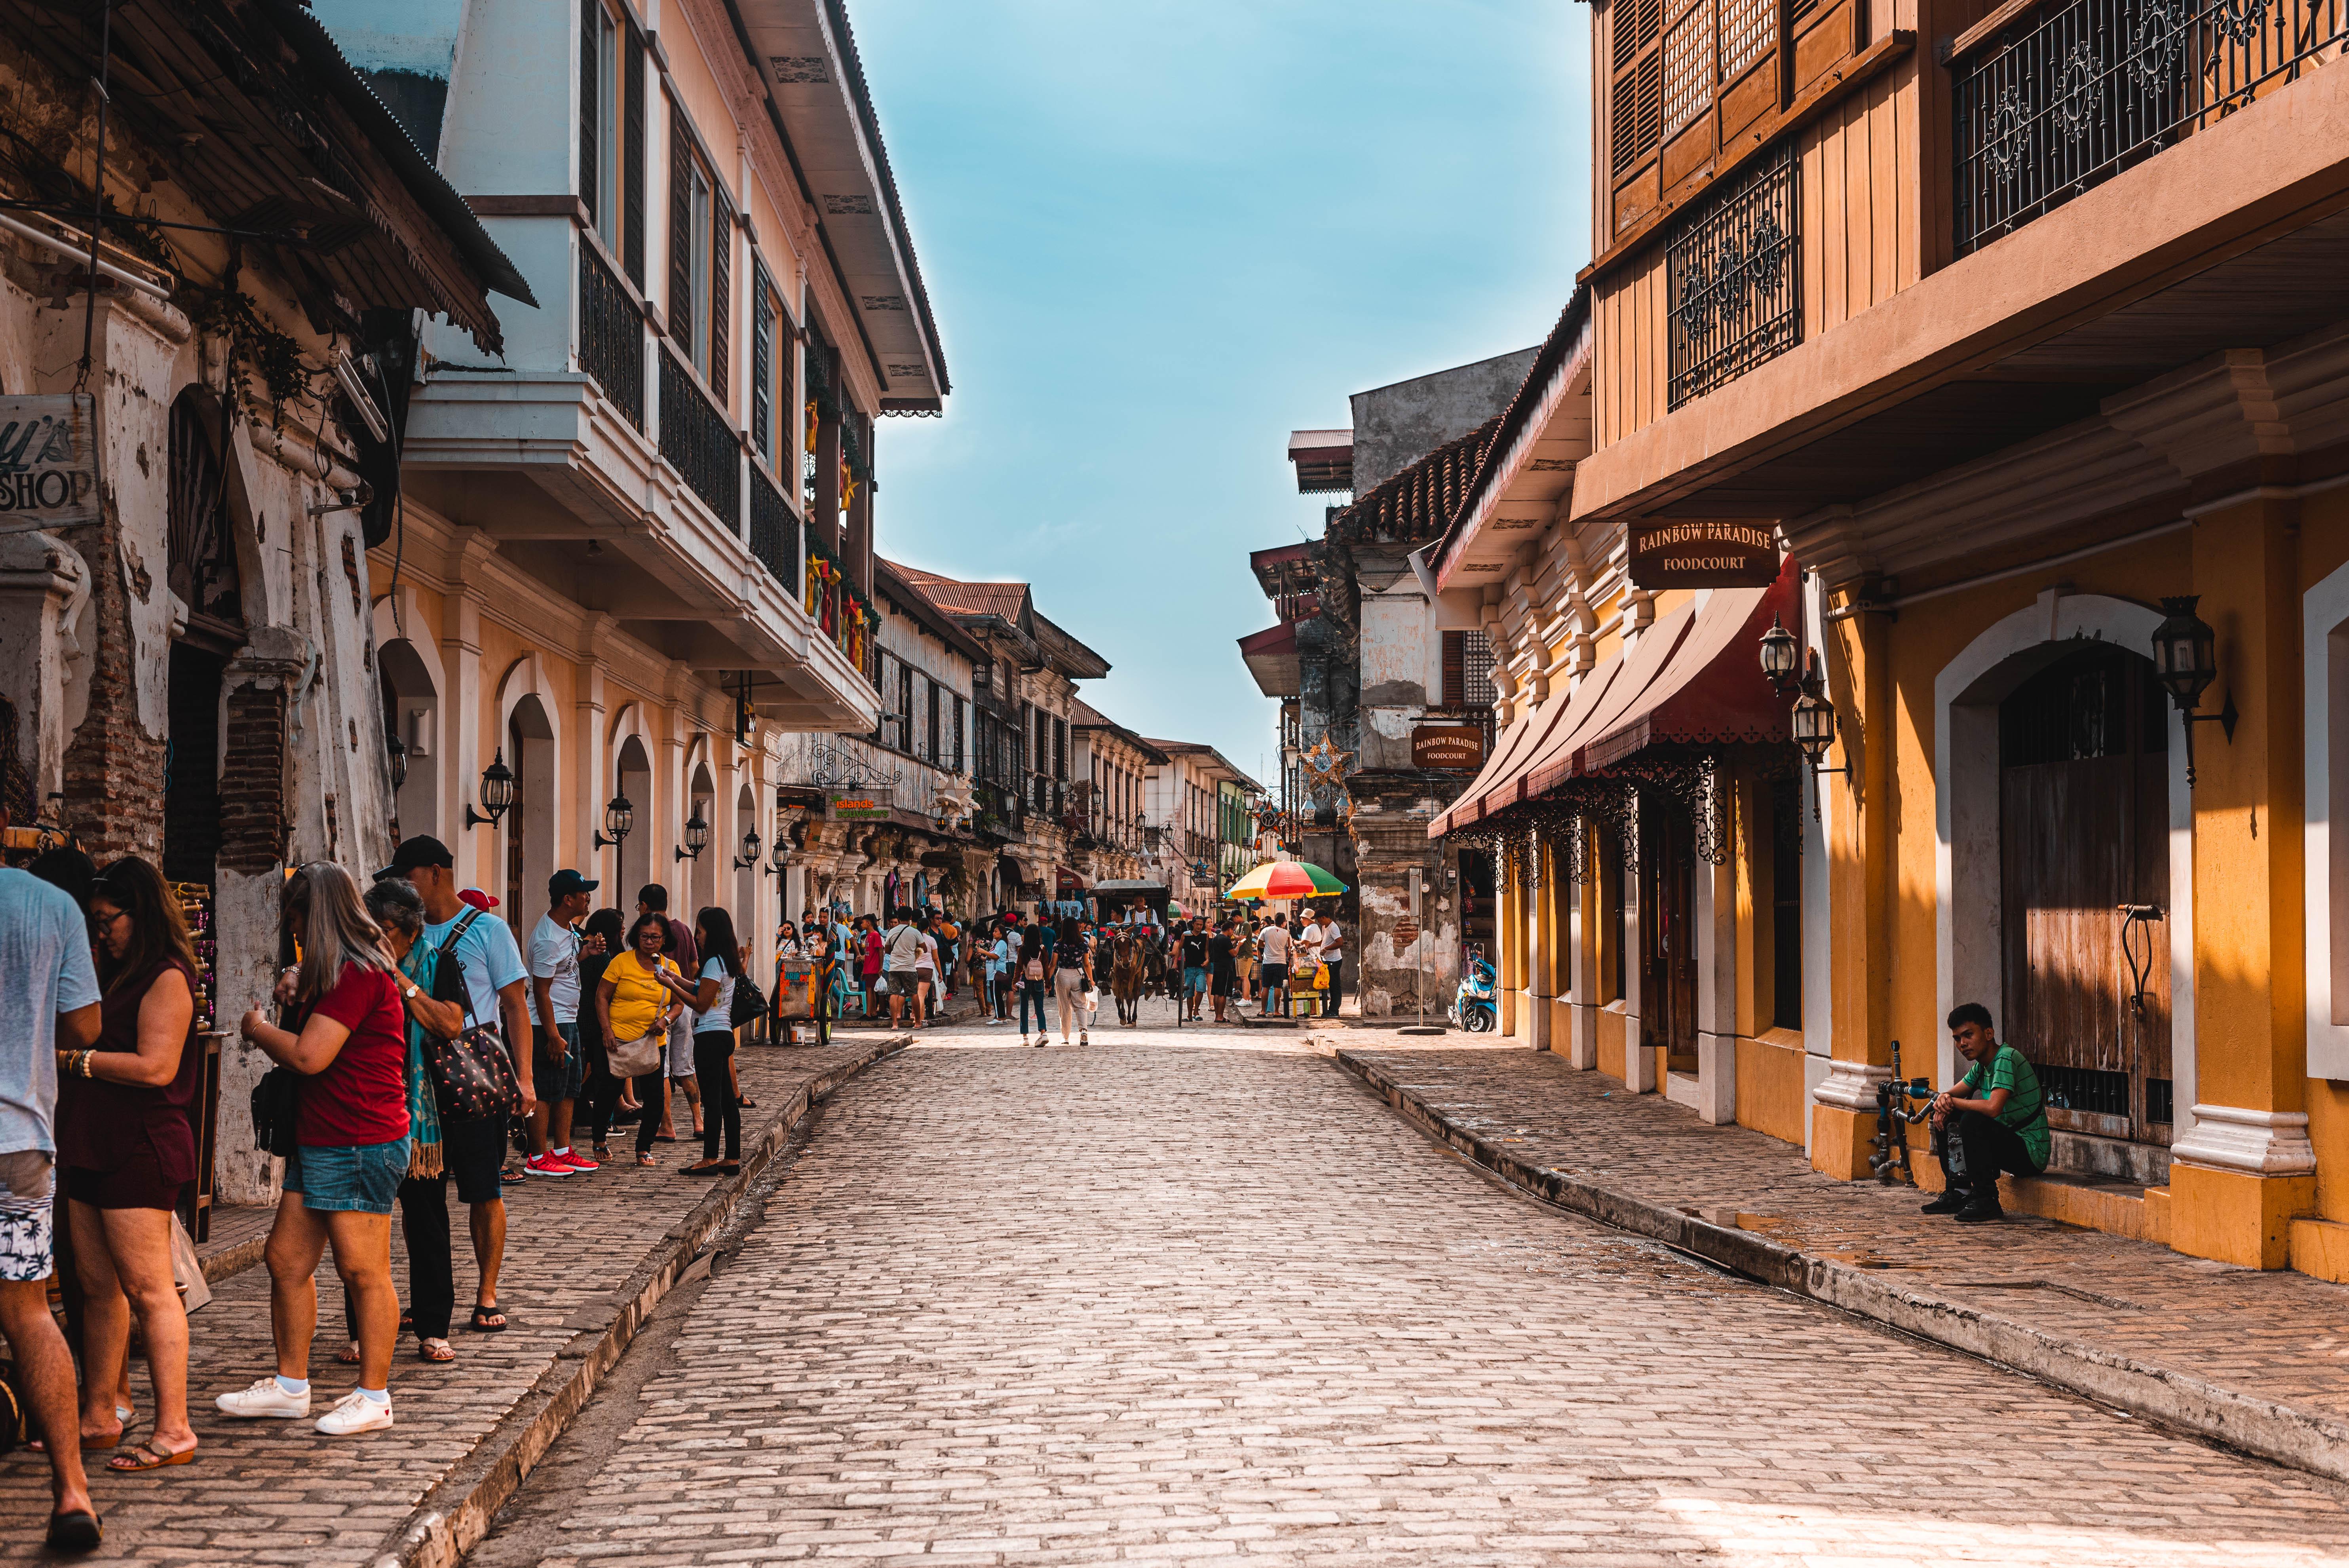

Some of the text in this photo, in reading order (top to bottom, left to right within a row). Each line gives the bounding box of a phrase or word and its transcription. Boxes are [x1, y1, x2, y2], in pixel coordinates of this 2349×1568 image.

[0, 469, 91, 511] SHOP
[1639, 522, 1770, 553] RAINBOW PARADISE
[1664, 557, 1746, 570] FOODCOURT
[1416, 737, 1478, 751] RAINBOW PARADISE
[836, 798, 874, 808] islands
[836, 810, 889, 818] souvenirs
